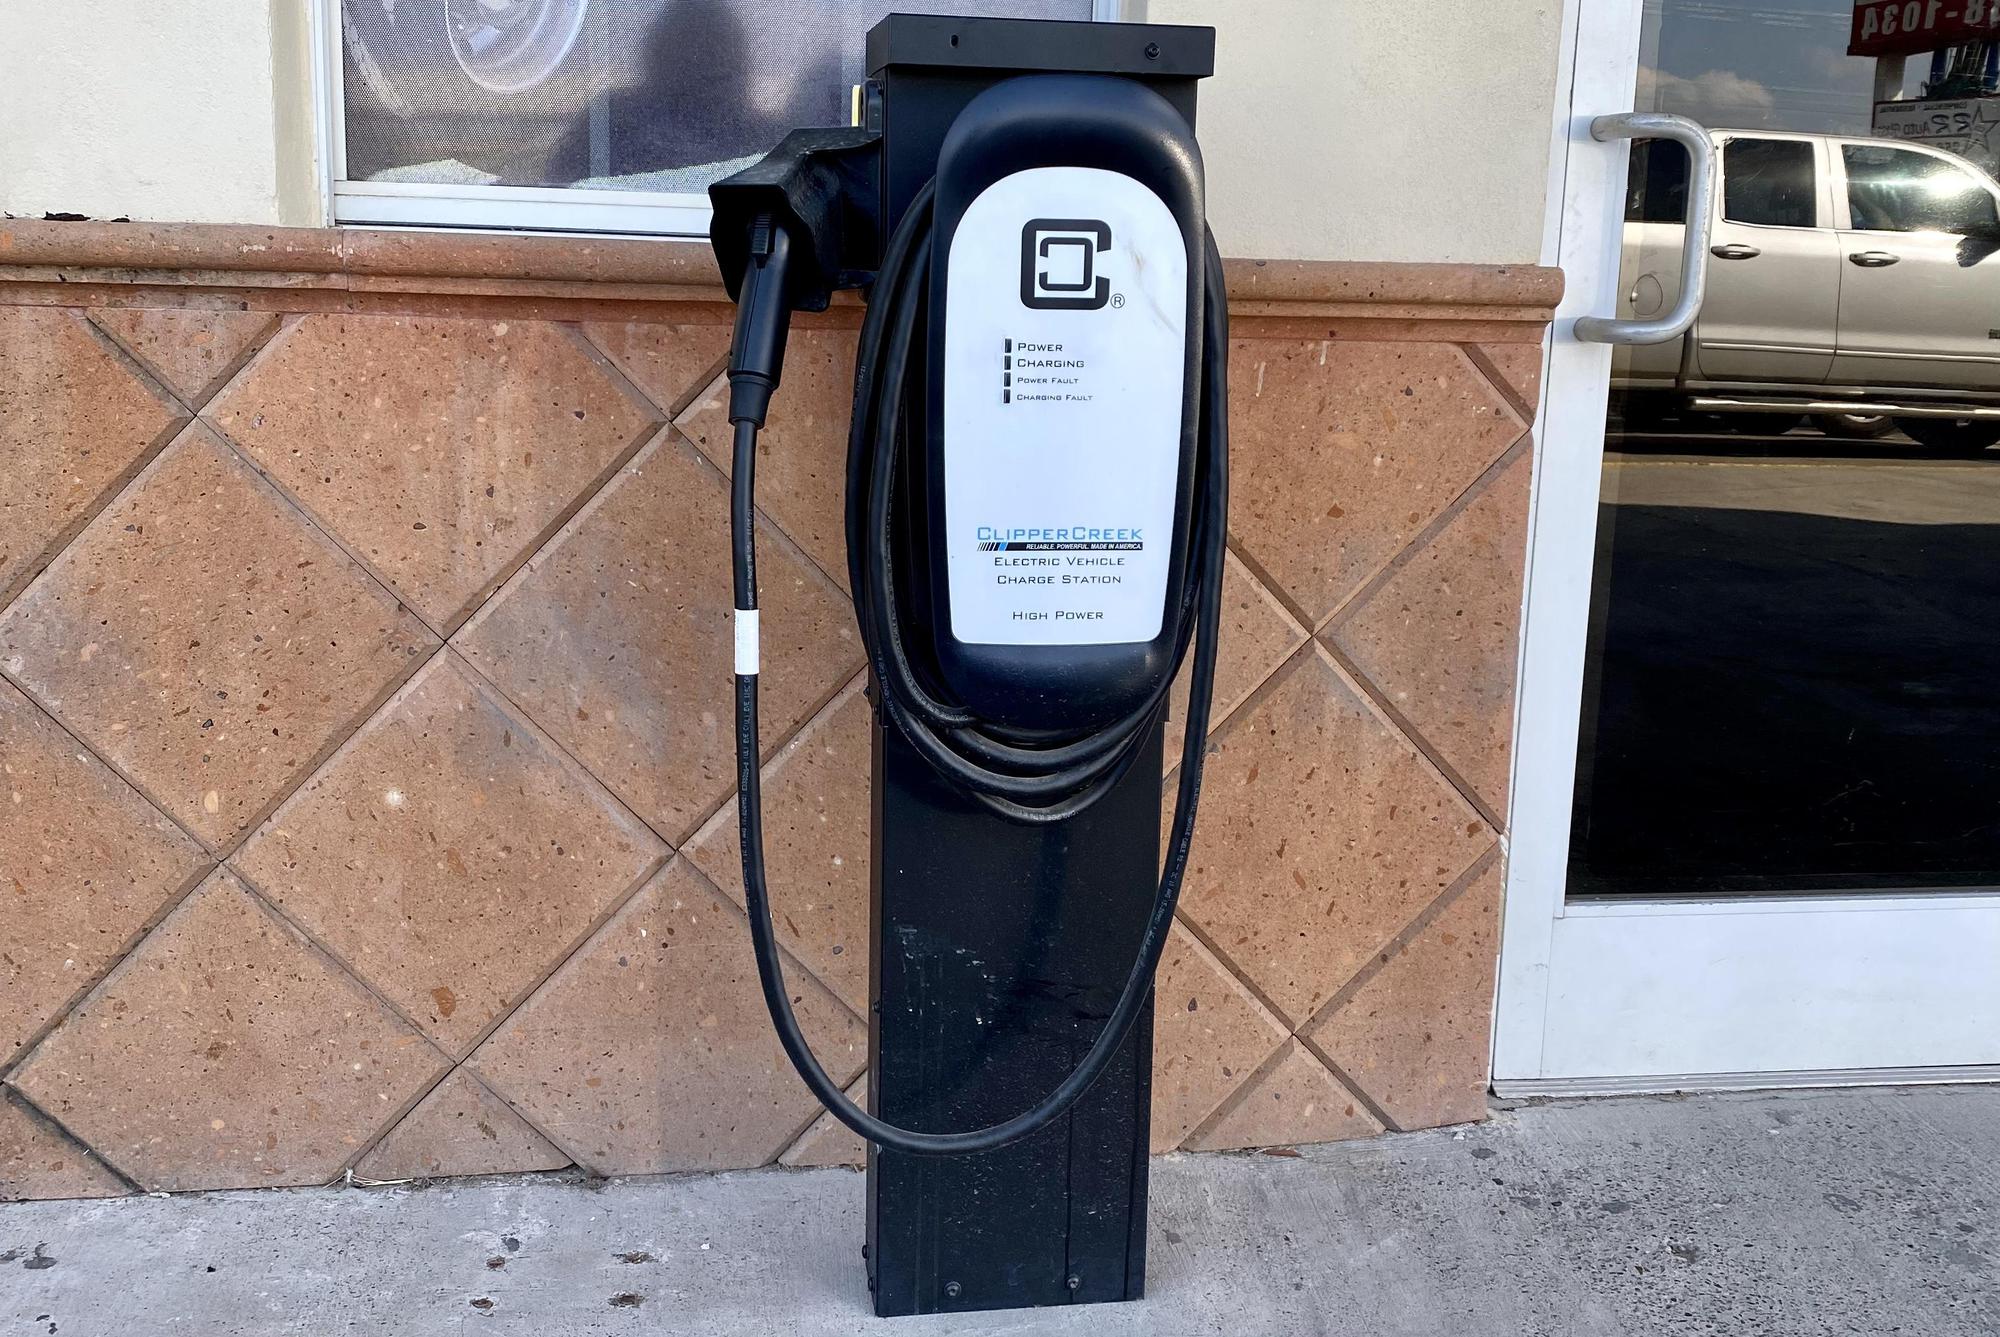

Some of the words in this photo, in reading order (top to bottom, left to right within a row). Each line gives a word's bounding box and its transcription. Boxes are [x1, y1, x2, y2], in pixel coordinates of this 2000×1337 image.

[1017, 342, 1063, 352] POWER
[1017, 358, 1085, 368] CHARGING
[994, 556, 1060, 567] ELECTRIC
[1066, 556, 1125, 567] VEHICLE
[997, 574, 1056, 585] CHARGE
[1061, 574, 1122, 584] STATION
[1012, 611, 1048, 620] HIGH
[1055, 610, 1104, 620] POWER
